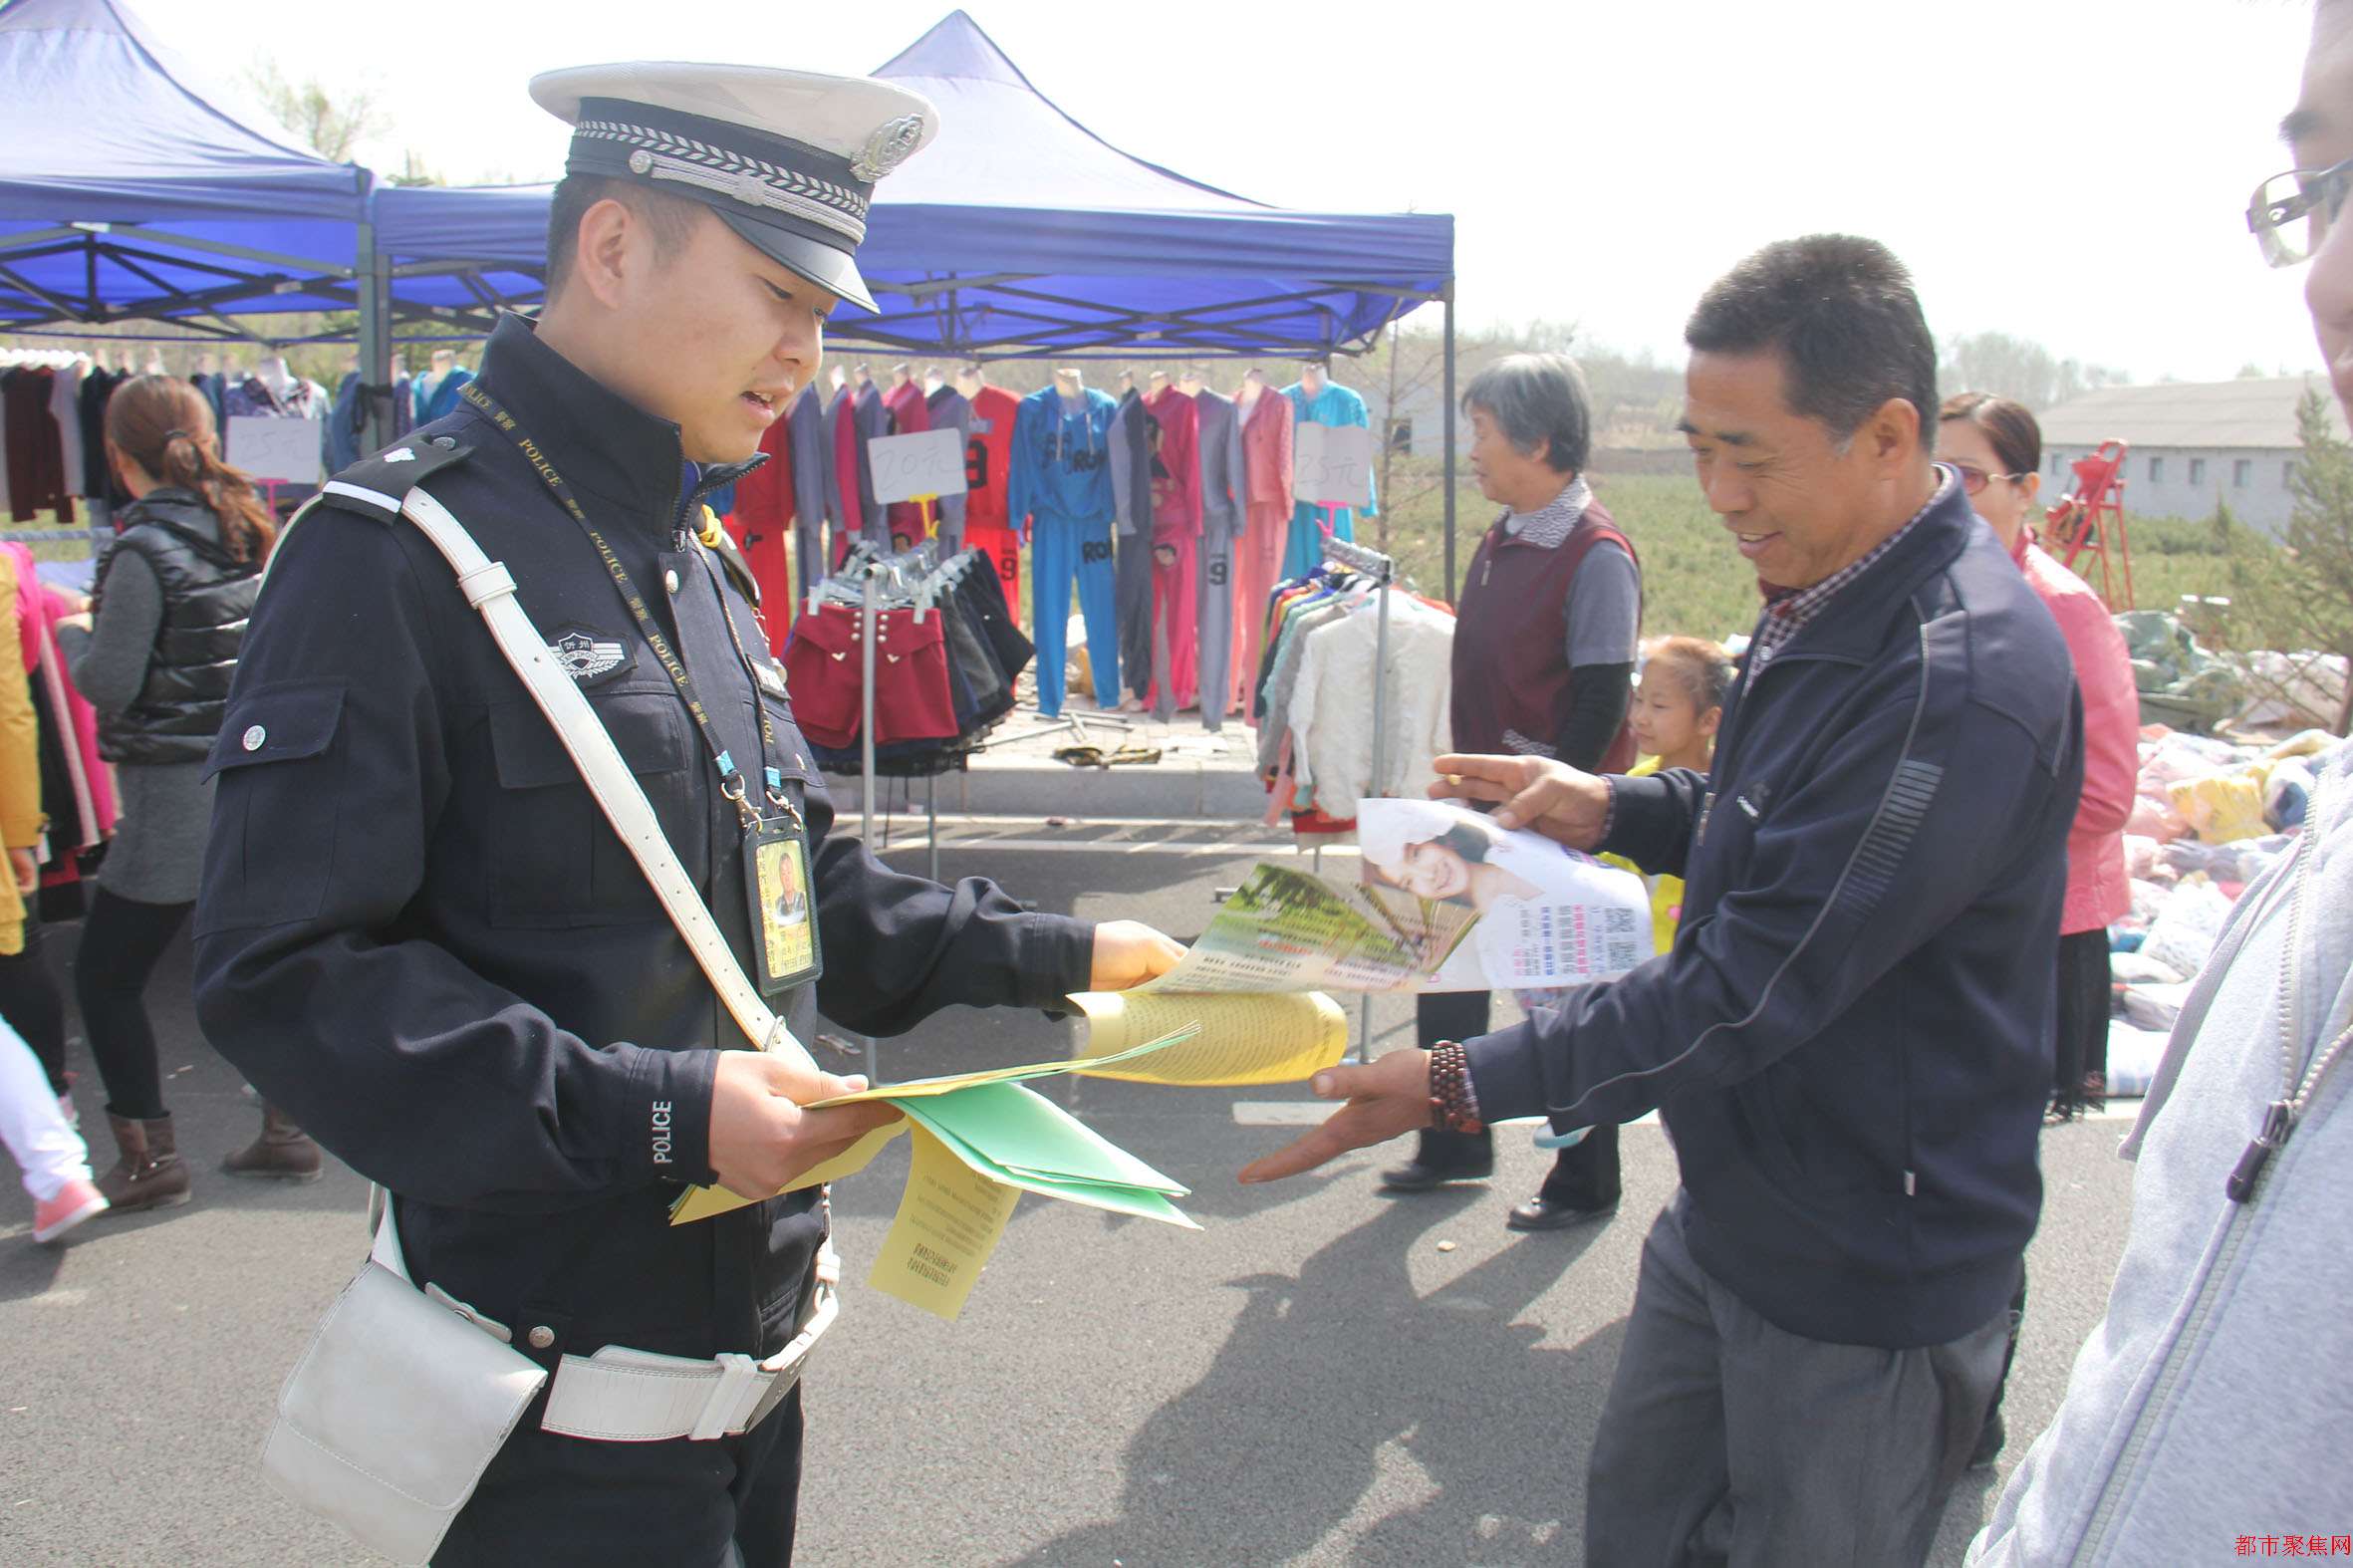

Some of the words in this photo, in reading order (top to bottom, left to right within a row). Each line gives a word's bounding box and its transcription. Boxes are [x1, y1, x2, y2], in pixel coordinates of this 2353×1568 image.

[518, 438, 564, 487] POLICE
[591, 531, 628, 583] POLICE
[650, 633, 689, 686] POLICE
[652, 1100, 673, 1165] POLICE
